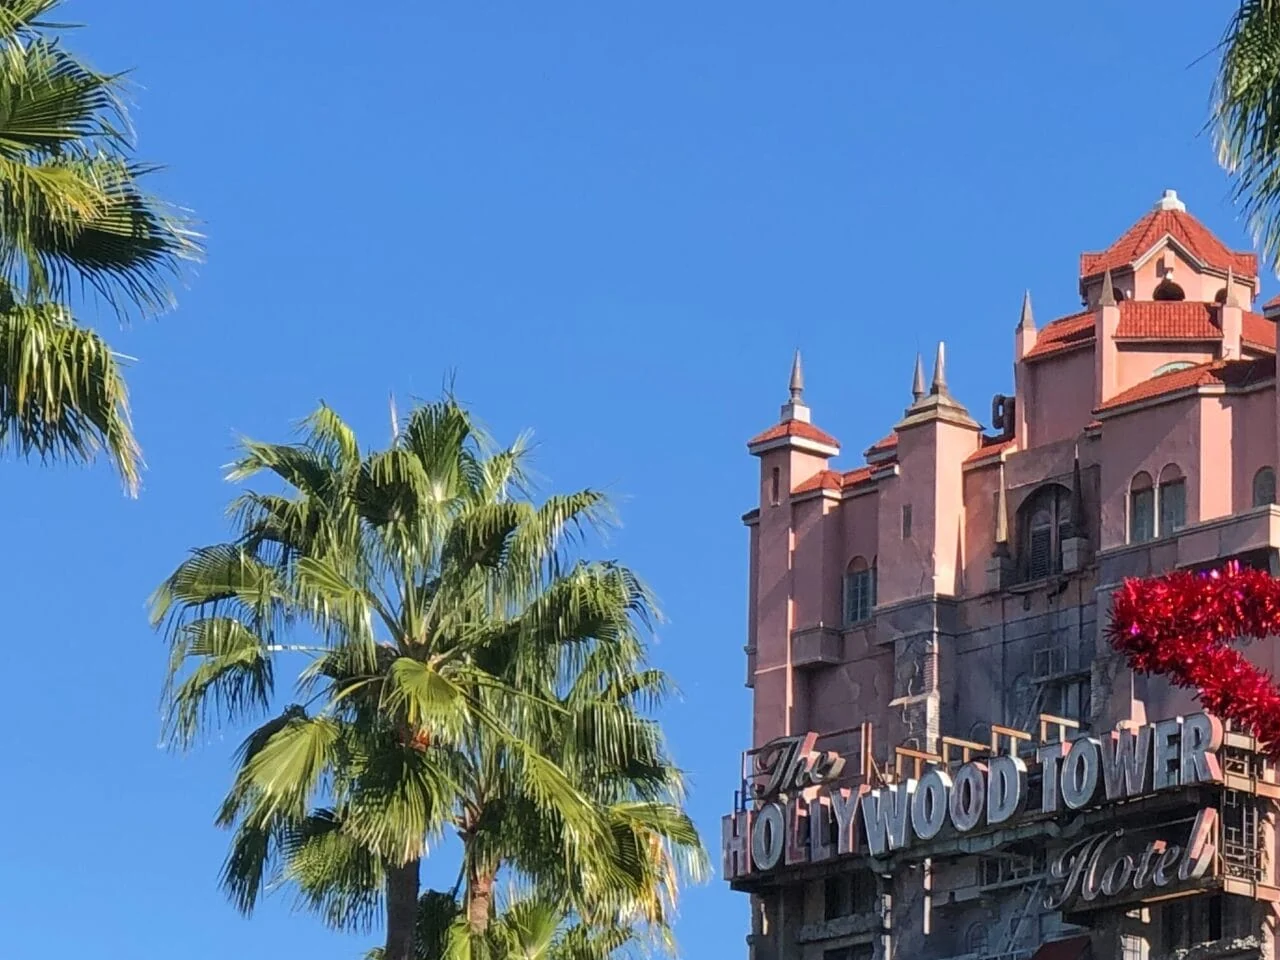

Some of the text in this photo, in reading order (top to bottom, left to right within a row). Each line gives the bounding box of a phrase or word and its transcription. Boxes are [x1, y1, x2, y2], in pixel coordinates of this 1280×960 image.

[722, 711, 1224, 881] HOLLYWOOD TOWER
[747, 731, 846, 801] The
[1044, 806, 1216, 909] Hotel
